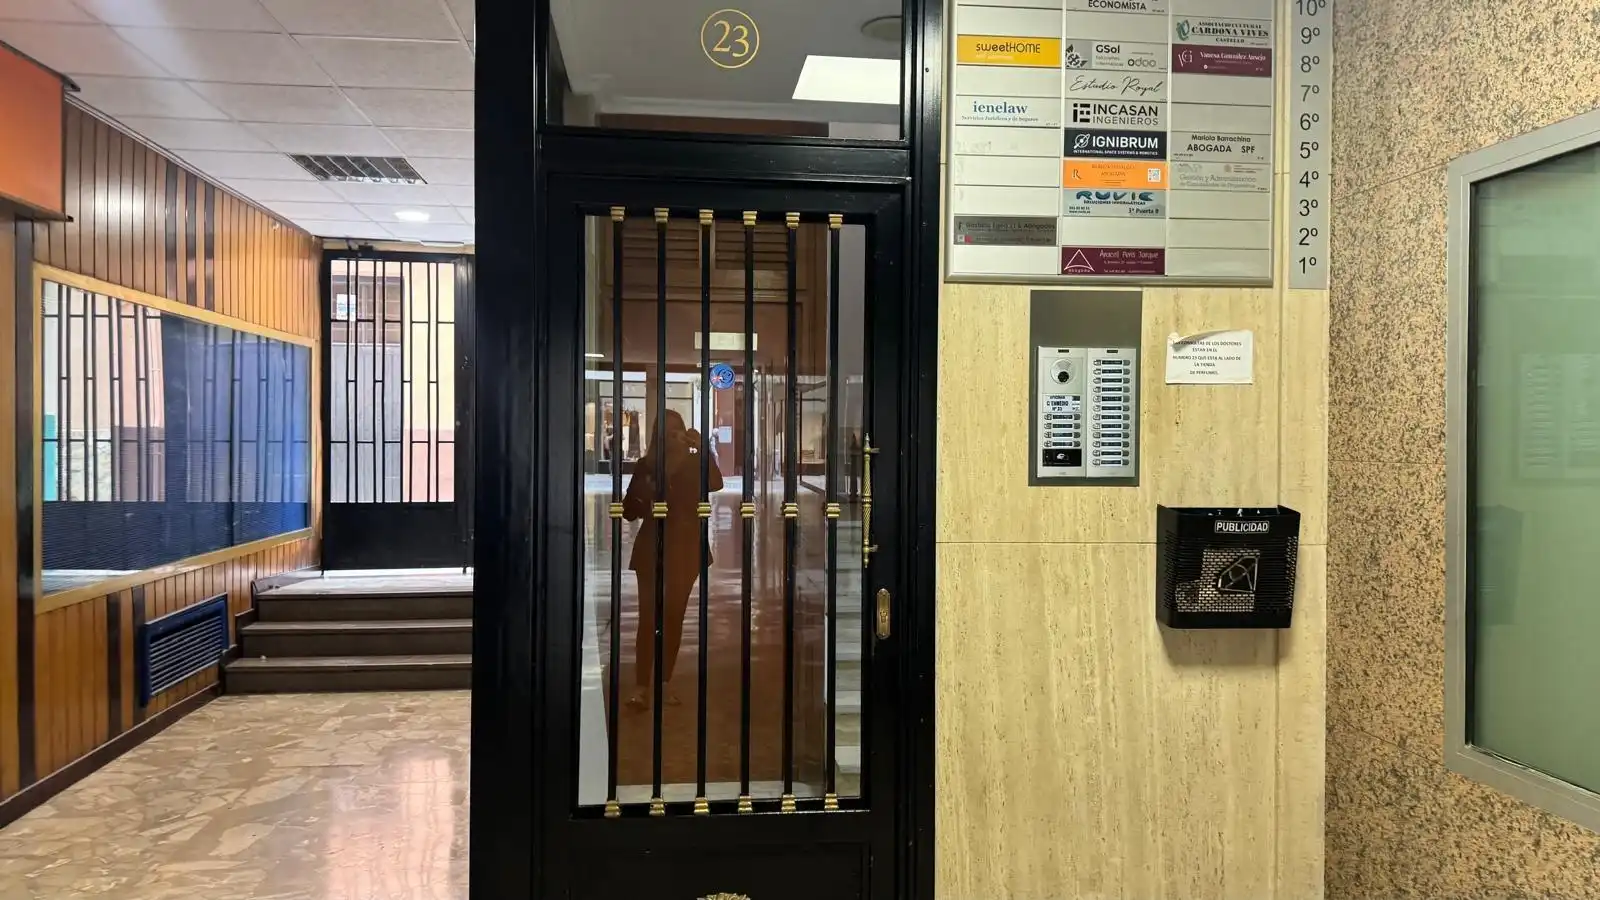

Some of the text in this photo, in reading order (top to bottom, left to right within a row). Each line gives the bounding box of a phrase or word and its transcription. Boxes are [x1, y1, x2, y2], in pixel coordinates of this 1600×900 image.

[1088, 0, 1146, 10] ECONOMISTA
[712, 20, 749, 57] 23
[1192, 26, 1268, 36] CARDONA VIVES
[1301, 27, 1320, 44] 9º
[976, 42, 1040, 54] sweetHOME
[1096, 44, 1120, 54] GSol
[1128, 56, 1156, 68] odoo
[1301, 56, 1320, 72] 8º
[1070, 74, 1164, 96] Estudio Royal
[1301, 84, 1320, 102] 7º
[974, 100, 1028, 114] ienelaw
[1093, 104, 1158, 117] INCASAN
[1092, 116, 1158, 126] INGENIEROS
[1300, 113, 1319, 130] 6º
[1187, 144, 1232, 152] ABOGADA
[1300, 142, 1319, 158] 5º
[1299, 170, 1319, 188] 4º
[1299, 199, 1318, 216] 3º
[1299, 228, 1318, 246] 2º
[1298, 256, 1316, 274] 1º
[1216, 522, 1268, 532] PUBLICIDAD
